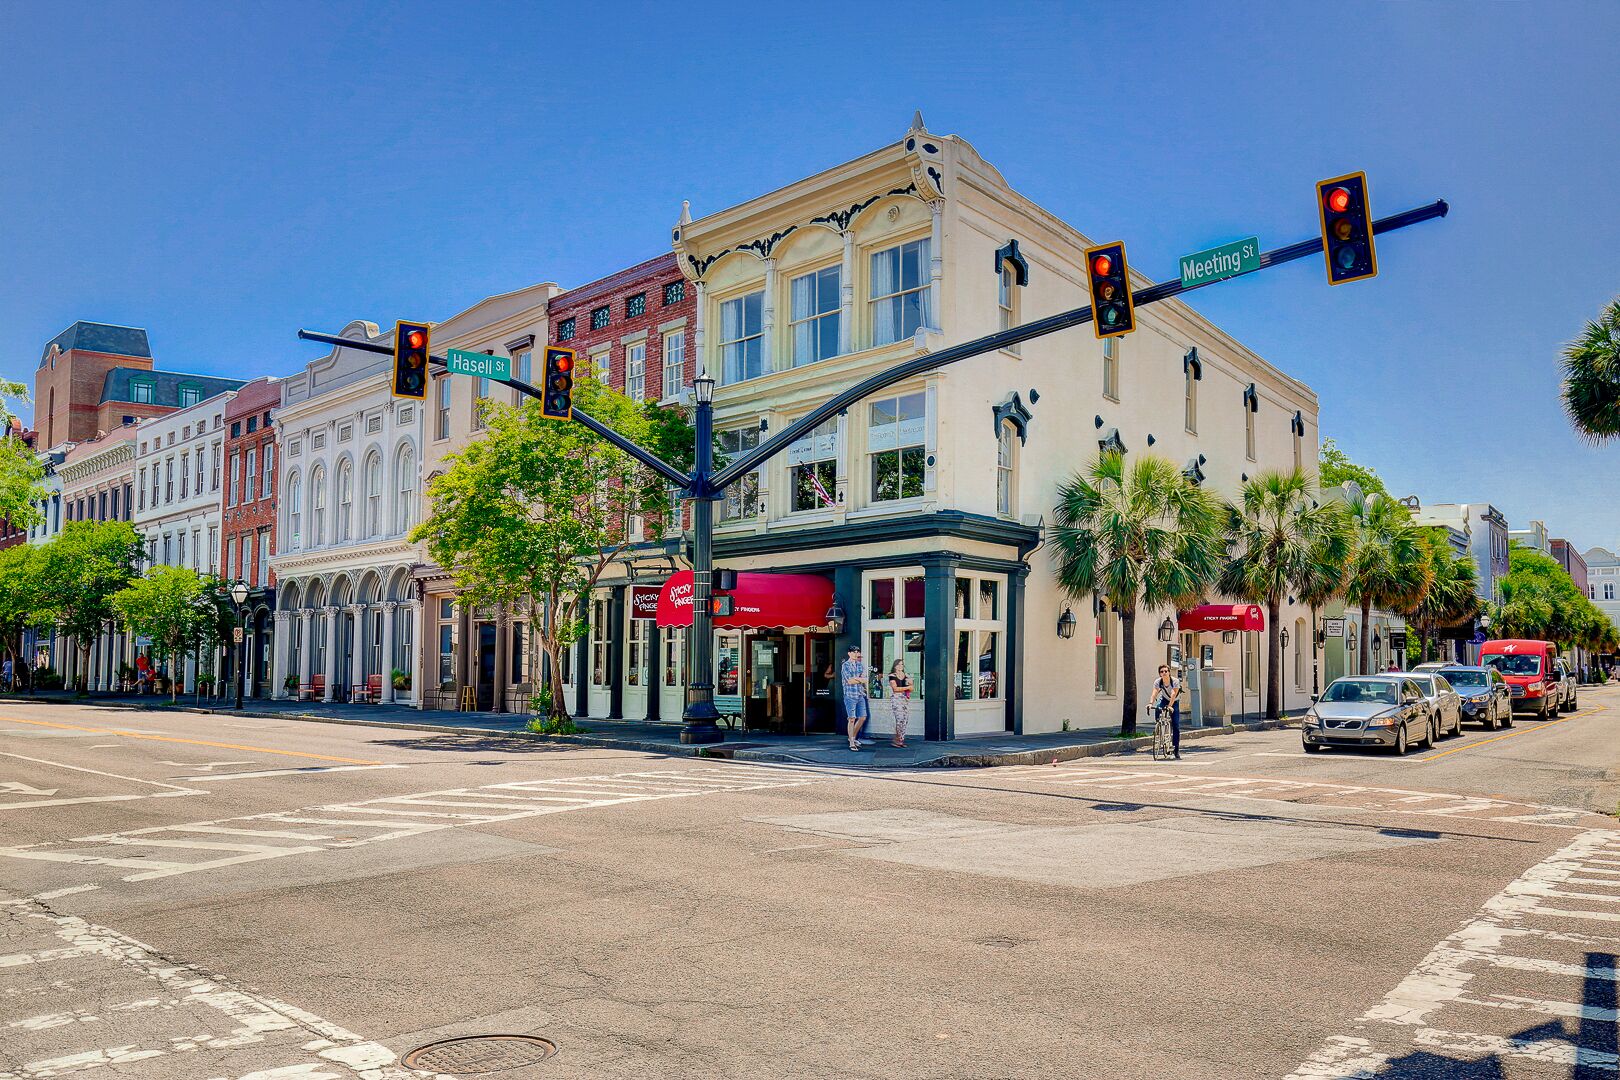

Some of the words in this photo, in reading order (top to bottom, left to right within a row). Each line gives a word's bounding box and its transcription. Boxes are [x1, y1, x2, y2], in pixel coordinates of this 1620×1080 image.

[1182, 252, 1241, 281] Meeting
[1242, 244, 1254, 259] St
[453, 353, 492, 375] Hasell
[495, 361, 505, 372] St
[633, 593, 660, 606] STICKY
[670, 583, 692, 602] STICKY
[639, 602, 658, 611] FINGE
